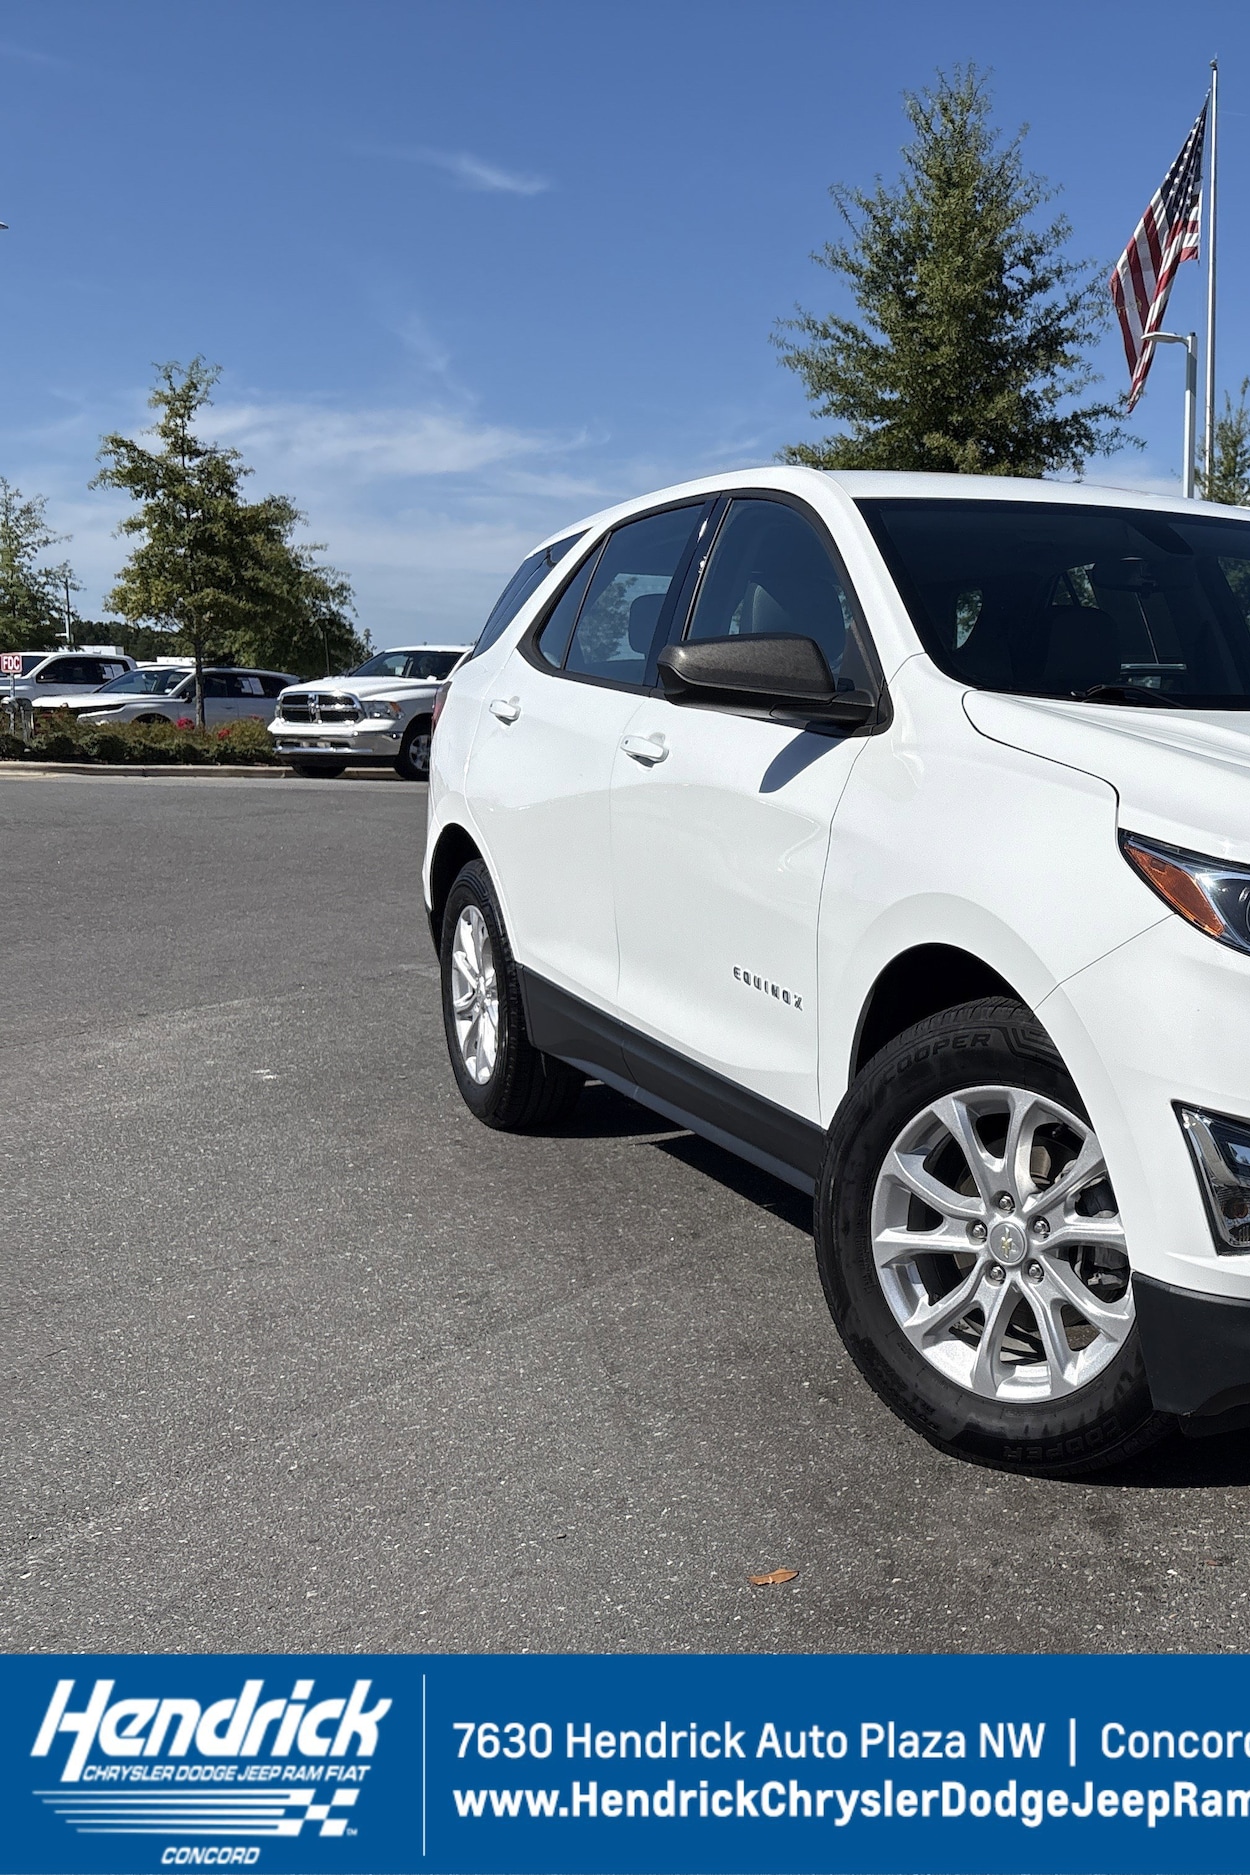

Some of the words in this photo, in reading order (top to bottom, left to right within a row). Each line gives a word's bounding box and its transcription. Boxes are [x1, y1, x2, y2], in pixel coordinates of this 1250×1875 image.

[3, 655, 20, 670] FDC
[733, 966, 803, 1011] EQUINOX
[880, 1032, 991, 1087] COOPER
